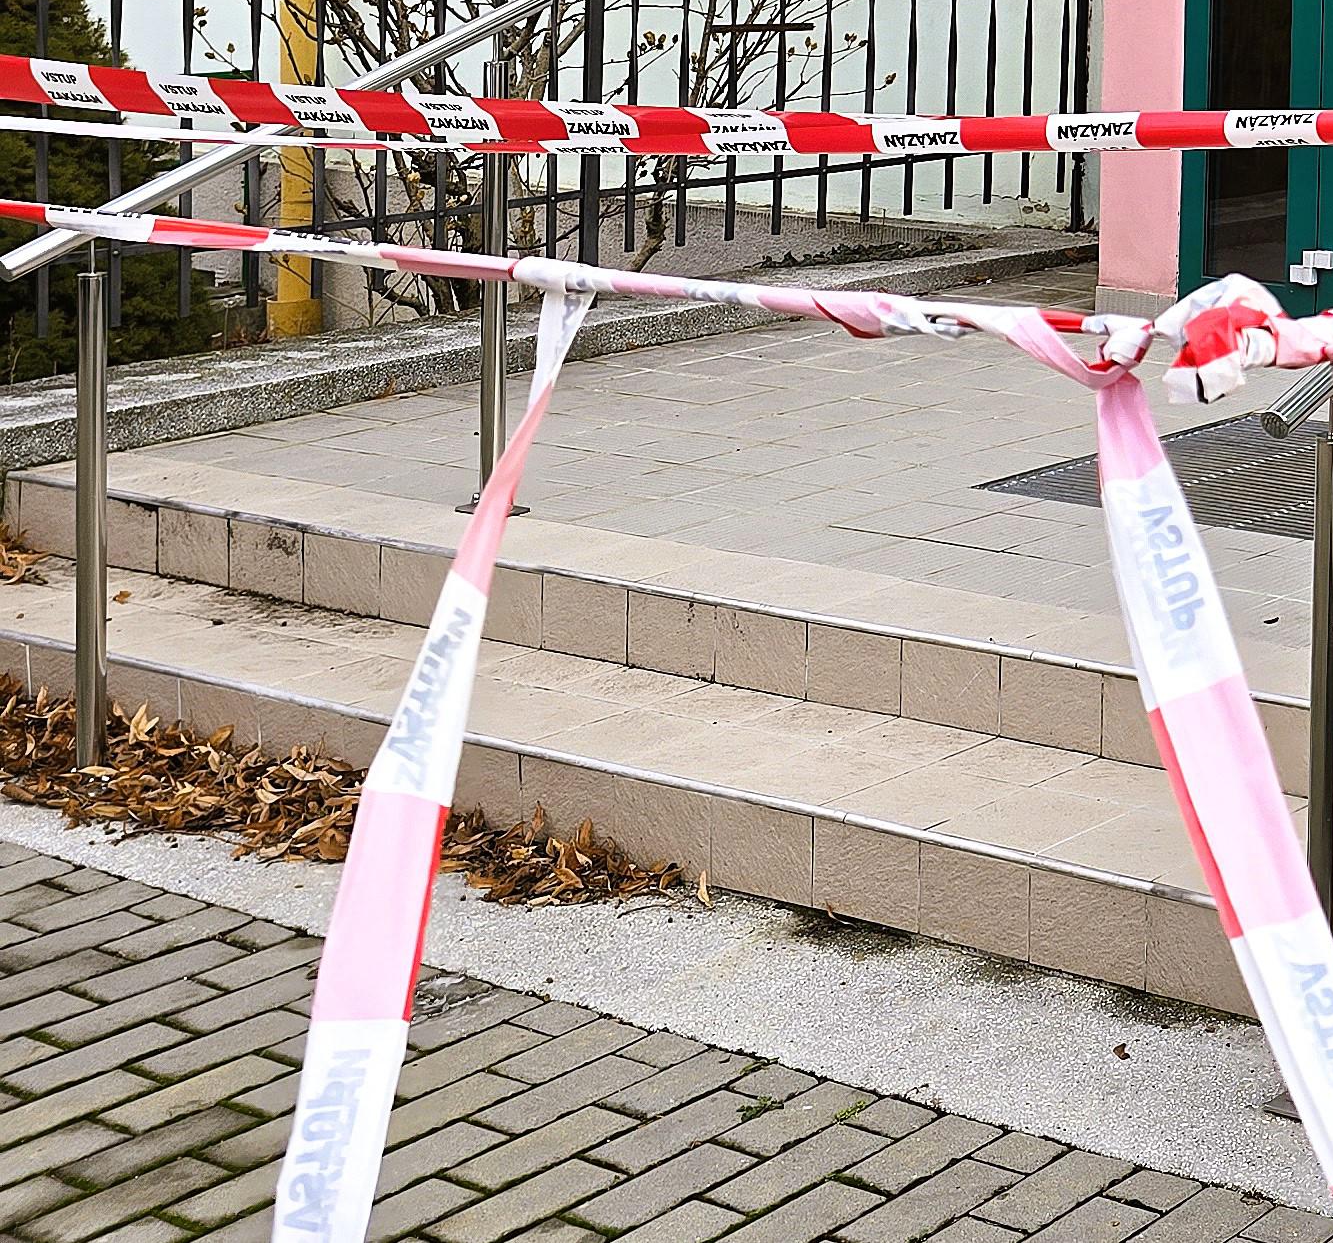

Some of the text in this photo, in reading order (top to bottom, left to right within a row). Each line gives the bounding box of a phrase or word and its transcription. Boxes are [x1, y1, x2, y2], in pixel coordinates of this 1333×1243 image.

[41, 71, 77, 85] VSTUP
[48, 90, 103, 105] ZAKÁZÁN
[159, 84, 198, 96] VSTUP
[285, 94, 327, 106] VSTUP
[167, 101, 225, 115] ZAKÁZÁN
[294, 109, 354, 124] ZAKÁZÁN
[427, 117, 490, 131] ZAKÁZÁN
[1235, 113, 1315, 131] ZAKÁZÁN
[567, 120, 631, 136] ZAKÁZÁN
[1057, 121, 1134, 141] ZAKÁZÁN
[884, 131, 959, 150] ZAKÁZÁN
